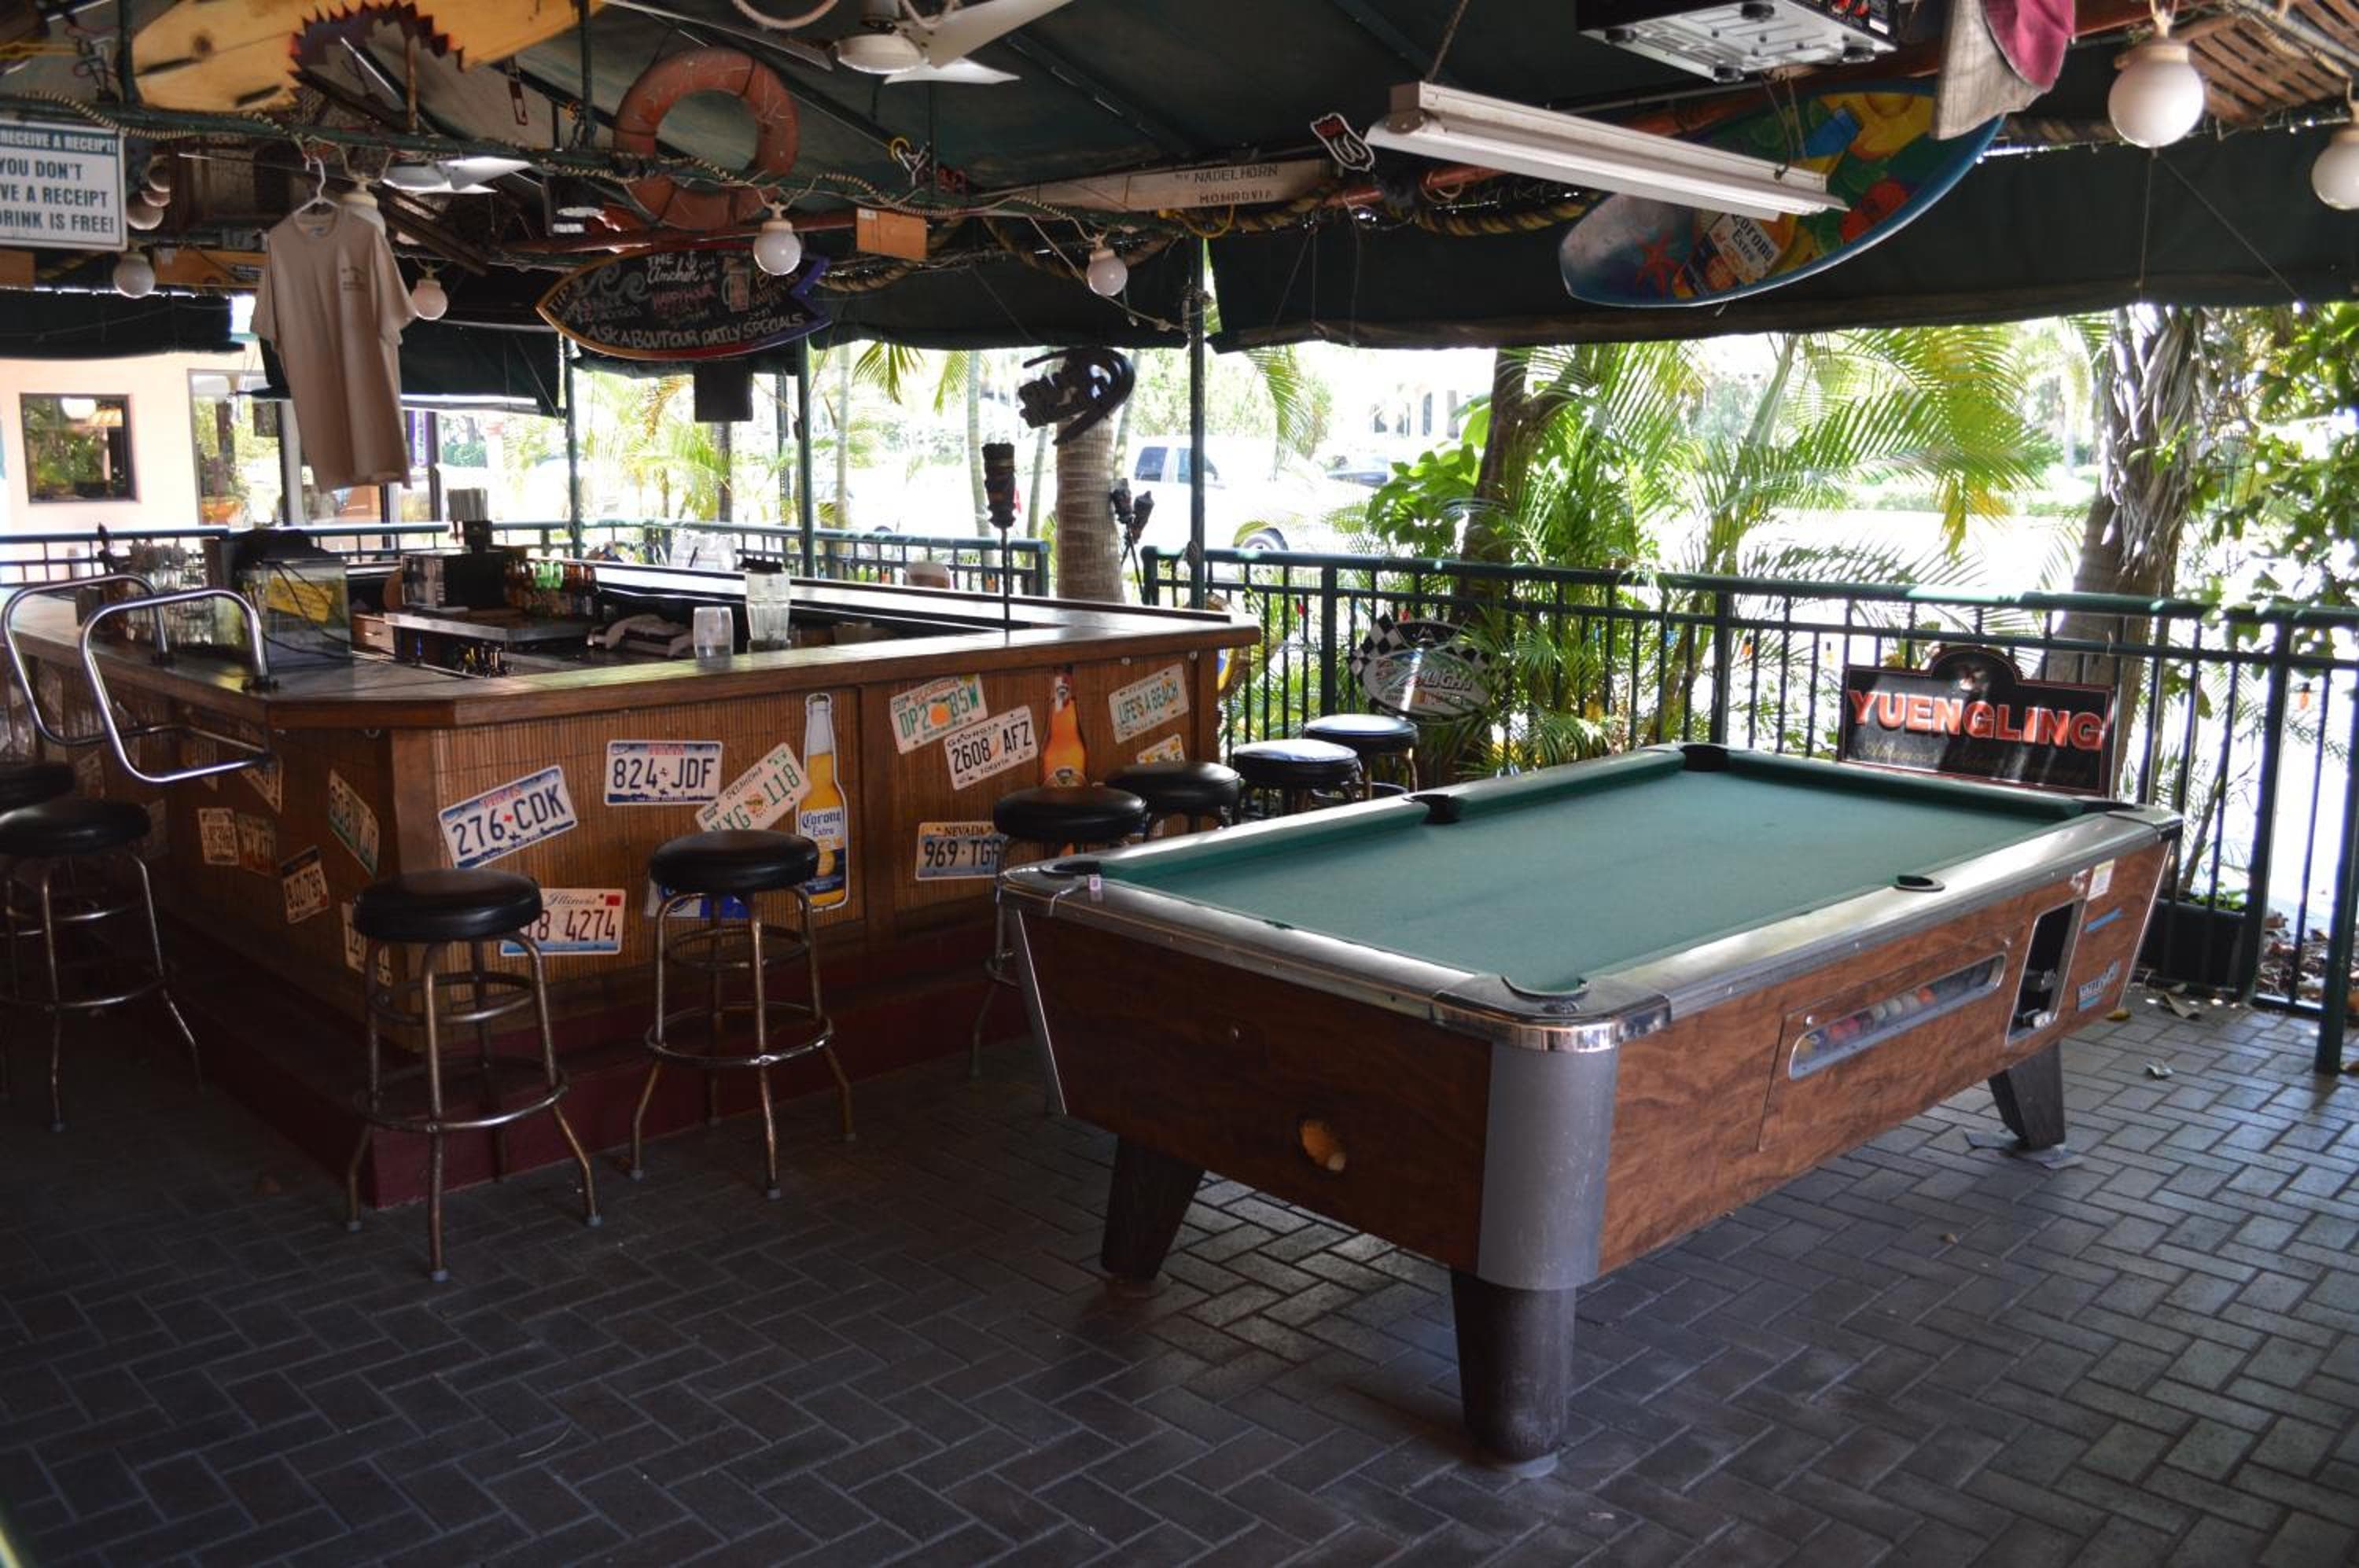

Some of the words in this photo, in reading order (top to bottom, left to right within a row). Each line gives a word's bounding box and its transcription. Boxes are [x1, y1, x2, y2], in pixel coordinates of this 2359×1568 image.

[53, 135, 61, 148] A
[64, 136, 116, 153] RECEIPT!
[35, 161, 83, 181] DON'T
[27, 186, 36, 202] A
[42, 186, 108, 208] RECEIPT
[50, 212, 64, 230] IS
[71, 214, 114, 234] FREE!
[647, 253, 674, 266] THE
[1848, 690, 2103, 752] YUENGLING
[948, 723, 999, 747] GEORGIA
[951, 738, 992, 774] 2608
[1003, 720, 1032, 754] AFZ
[613, 758, 658, 790] 824
[671, 758, 715, 790] JDF
[764, 763, 800, 806] 118
[452, 808, 505, 856] 276
[513, 784, 565, 830] CDK
[944, 825, 984, 837] NEVADA
[925, 839, 958, 868] 969
[565, 909, 616, 941] 4274
